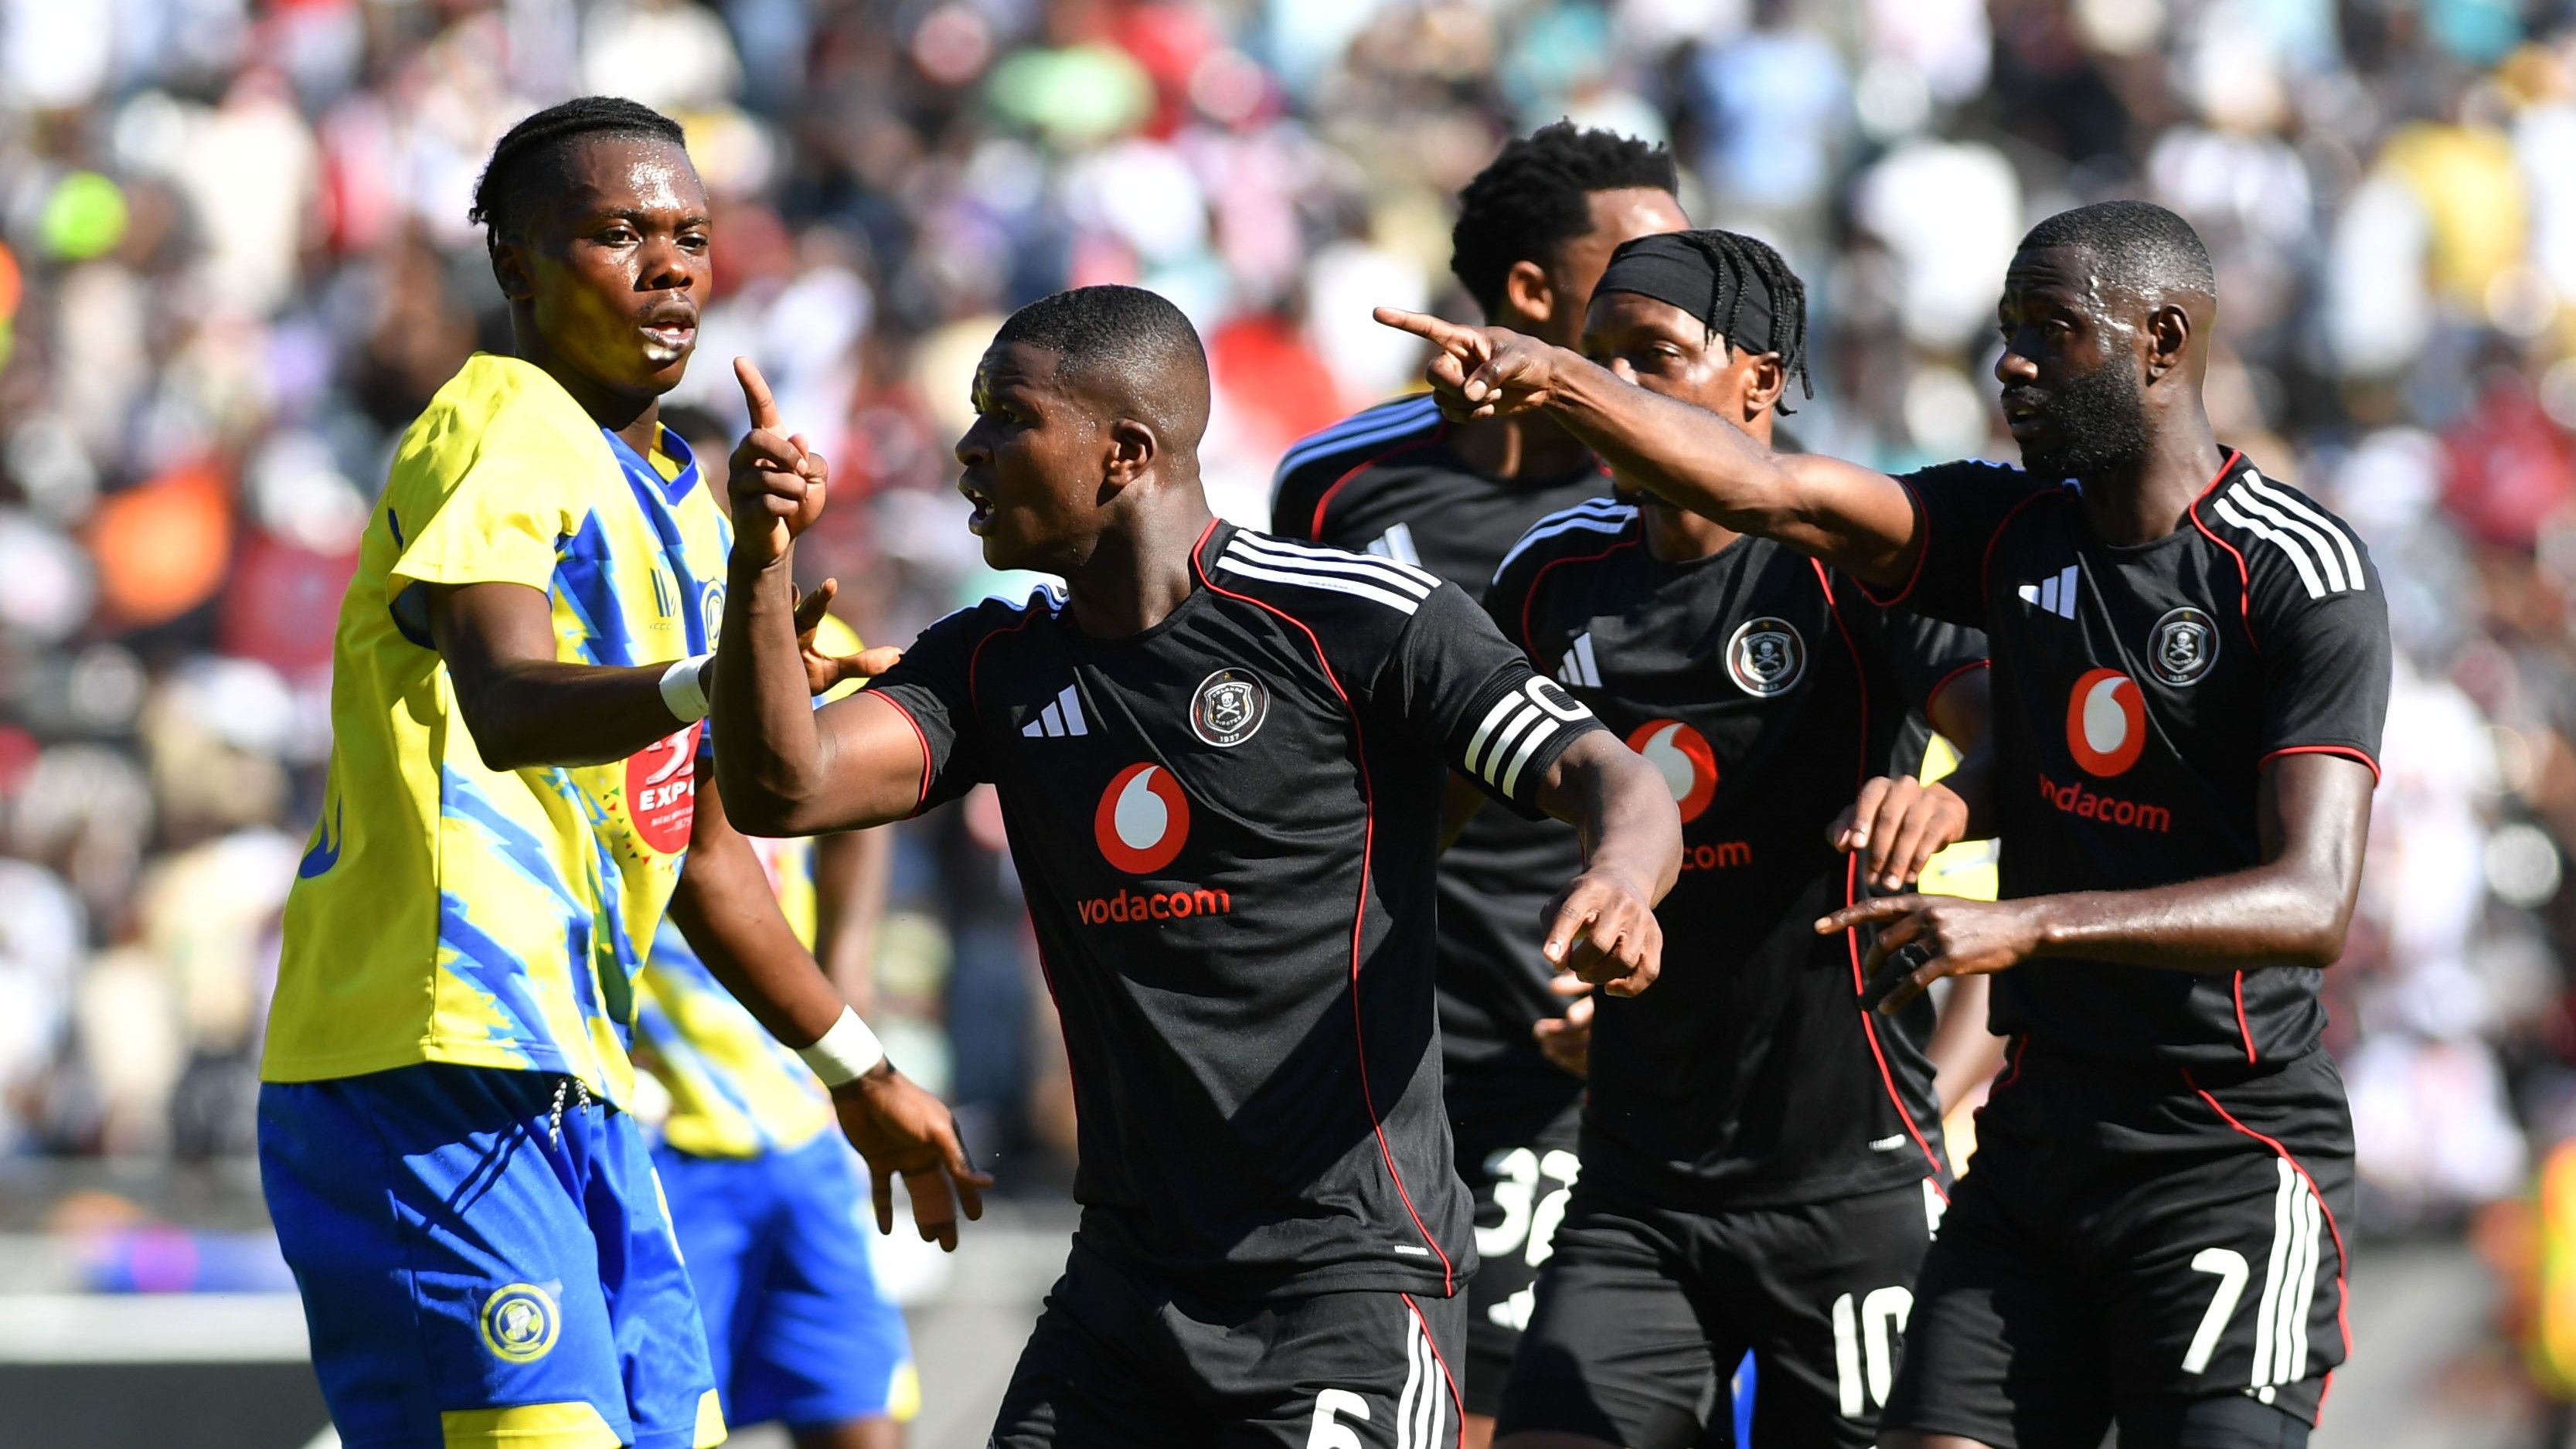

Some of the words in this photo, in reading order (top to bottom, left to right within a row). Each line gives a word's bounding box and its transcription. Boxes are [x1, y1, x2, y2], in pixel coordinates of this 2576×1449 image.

[1077, 888, 1231, 927] vodacom
[1832, 1285, 1914, 1419] 10
[2180, 1247, 2251, 1375] 7
